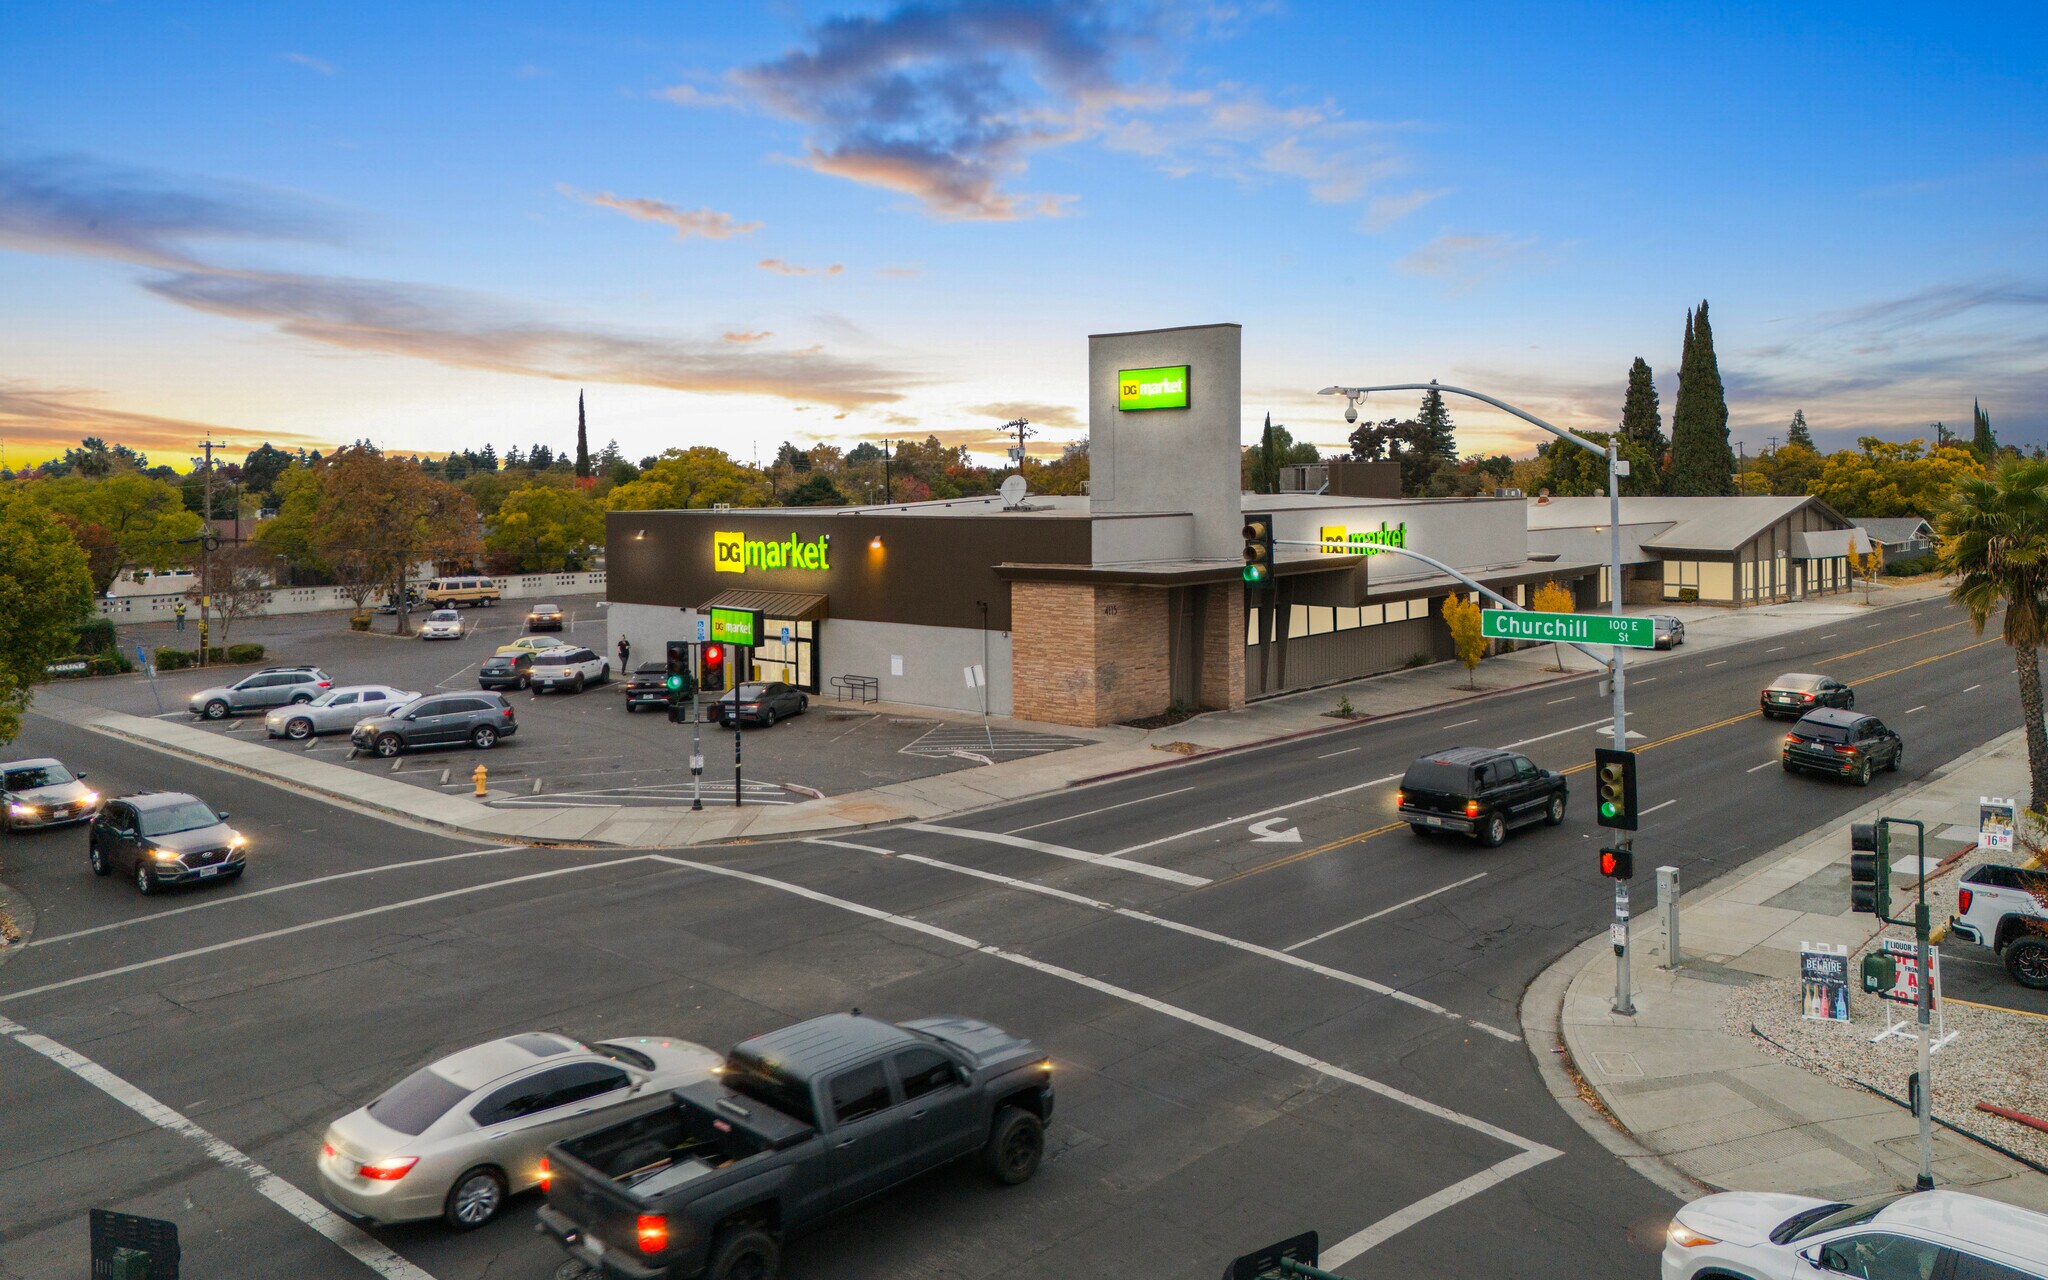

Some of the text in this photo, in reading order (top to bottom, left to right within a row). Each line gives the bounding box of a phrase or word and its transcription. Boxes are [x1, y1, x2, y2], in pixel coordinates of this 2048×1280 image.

[1123, 378, 1183, 396] DG market
[1325, 521, 1407, 556] DG market
[718, 531, 829, 571] DG market
[715, 622, 724, 631] DG
[725, 621, 751, 635] market
[1496, 615, 1639, 638] Churchill 100 E
[1618, 632, 1629, 642] St
[1890, 941, 1912, 952] LIQUOR
[1806, 959, 1842, 972] BELAIRE
